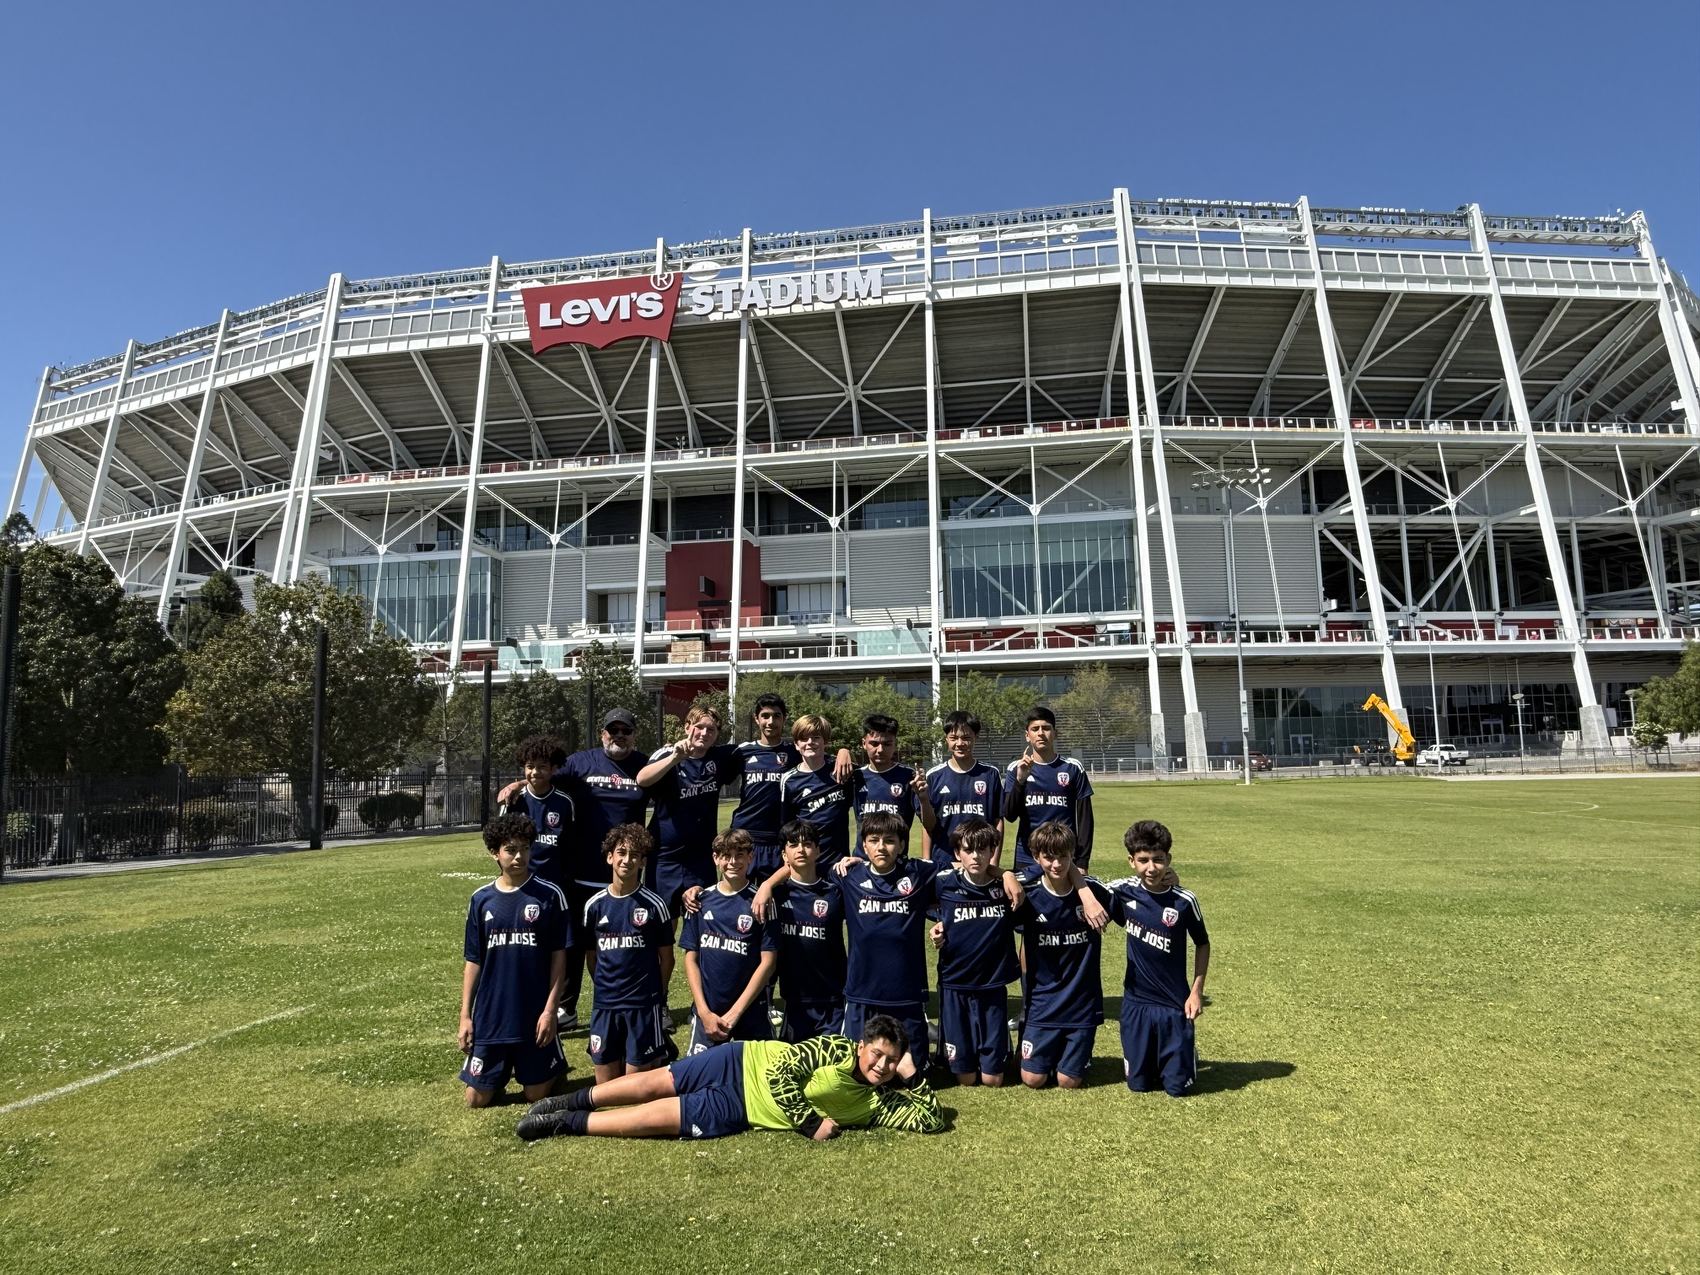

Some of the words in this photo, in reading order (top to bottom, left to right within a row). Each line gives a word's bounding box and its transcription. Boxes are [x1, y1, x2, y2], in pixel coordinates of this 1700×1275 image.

[691, 267, 882, 316] STADIUM
[745, 772, 763, 785] SAN
[680, 787, 698, 799] SAN
[1025, 794, 1044, 807] SAN
[1045, 795, 1068, 807] JOSE
[807, 796, 825, 813] SAN
[859, 802, 876, 816] SAN
[942, 804, 960, 818] SAN
[961, 803, 985, 817] JOSE
[534, 833, 558, 847] JOSE
[858, 898, 880, 914] SAN
[882, 900, 910, 915] JOSE
[953, 906, 977, 923] SAN
[979, 903, 1006, 918] JOSE
[508, 932, 537, 947] JOSE
[798, 925, 826, 940] JOSE
[1038, 933, 1060, 946] SAN
[1062, 930, 1089, 945] JOSE
[598, 937, 619, 951] SAN
[619, 935, 646, 948] JOSE
[700, 933, 720, 949] SAN
[720, 938, 748, 956] JOSE
[1141, 931, 1171, 954] JOSE
